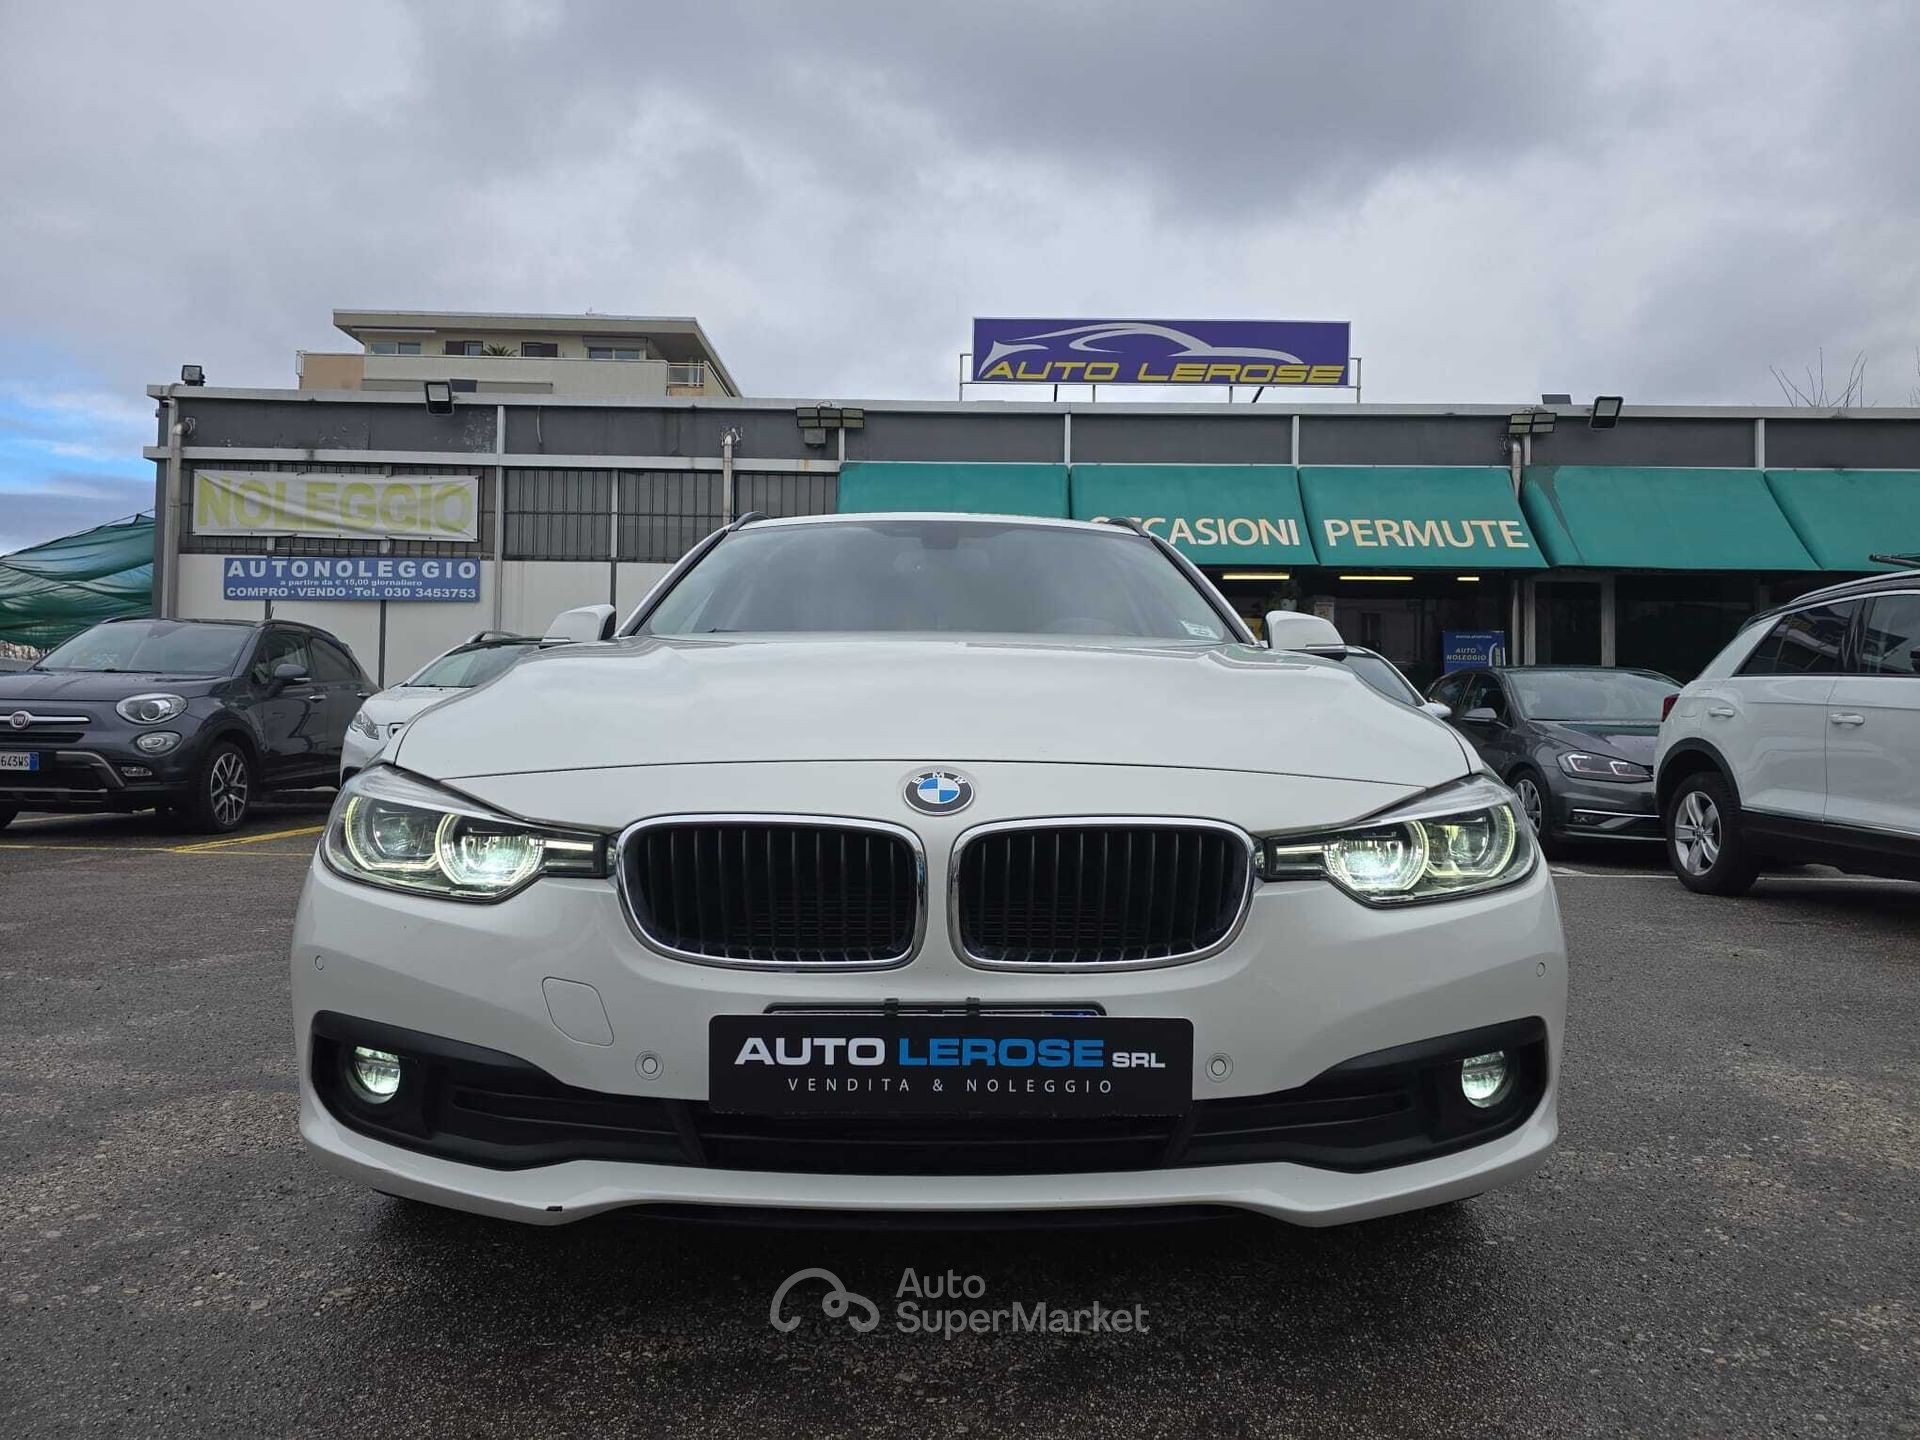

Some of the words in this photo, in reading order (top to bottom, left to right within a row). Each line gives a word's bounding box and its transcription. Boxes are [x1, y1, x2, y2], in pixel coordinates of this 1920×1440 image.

[983, 360, 1120, 381] AUTO
[1137, 362, 1344, 384] LEROSE
[199, 477, 473, 534] NOLEGGIO
[1090, 516, 1301, 546] CASIONI
[1323, 518, 1530, 549] PERMUTE
[227, 560, 477, 579] AUTONOLEGGIO
[226, 587, 289, 597] COMPRO
[298, 587, 346, 597] VENDO
[354, 587, 380, 597] Tel.
[384, 588, 411, 598] 030
[415, 588, 477, 598] 3453753
[288, 579, 319, 587] partire
[371, 579, 423, 587] giornaliero
[733, 1037, 886, 1067] AUTO
[899, 1038, 1104, 1068] LEROSE
[1112, 1051, 1166, 1069] SRL
[788, 1077, 909, 1092] VENDITA
[932, 1078, 944, 1093] &
[966, 1078, 1112, 1094] NOLEGGIO
